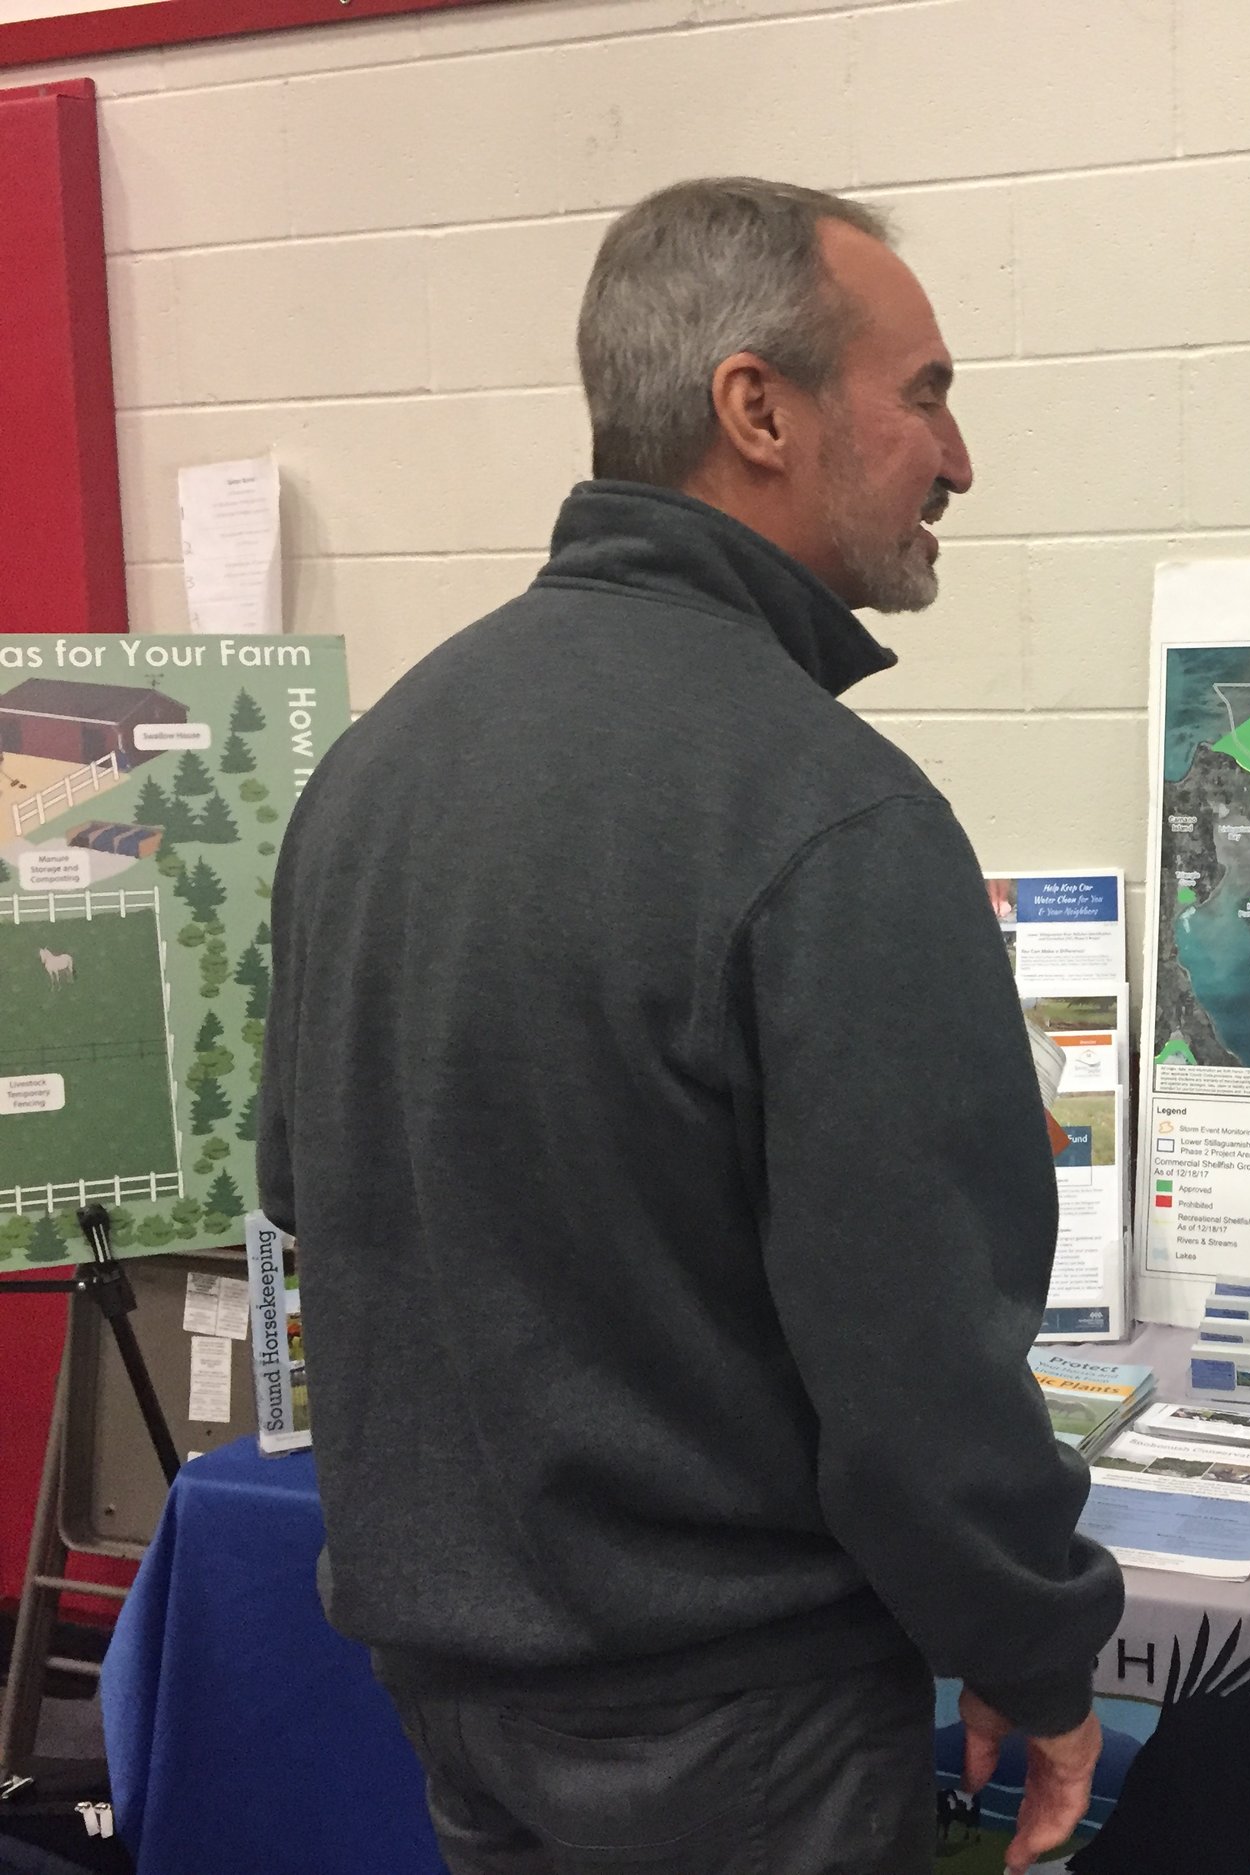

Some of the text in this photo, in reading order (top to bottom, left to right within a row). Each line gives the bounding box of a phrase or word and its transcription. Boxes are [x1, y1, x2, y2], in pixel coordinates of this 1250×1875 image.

[0, 639, 311, 667] as for Your Farm
[143, 731, 200, 741] Swallow House
[1169, 815, 1197, 823] Camano
[39, 855, 69, 863] Manure
[30, 864, 79, 874] Storage and
[30, 874, 80, 884] Composting
[1043, 883, 1094, 893] Help Keep Our
[1034, 894, 1104, 905] Water Clean for You
[9, 1078, 46, 1088] Livestock
[7, 1089, 50, 1099] Temporary
[13, 1099, 45, 1109] Fencing
[1157, 1106, 1187, 1116] Legend
[1200, 1126, 1220, 1134] Event
[1204, 1139, 1250, 1149] Stillaguamish
[1181, 1147, 1203, 1155] Phase
[1211, 1149, 1236, 1158] Project
[1154, 1157, 1200, 1167] Commercial
[1202, 1160, 1234, 1169] Shellfish
[1154, 1168, 1209, 1178] As of 12/18/17
[1179, 1185, 1212, 1194] Approved
[1178, 1200, 1213, 1210] Prohibited
[1178, 1214, 1221, 1223] Recreational
[1177, 1223, 1228, 1233] As of 12/18/17
[1177, 1236, 1199, 1245] Rivers
[1208, 1238, 1238, 1247] Streams
[1175, 1252, 1197, 1260] Lakes
[258, 1230, 285, 1433] Sound Horsekeeping
[1049, 1356, 1120, 1373] Protect
[1060, 1381, 1120, 1394] Plants
[1129, 1438, 1191, 1453] Snohomish
